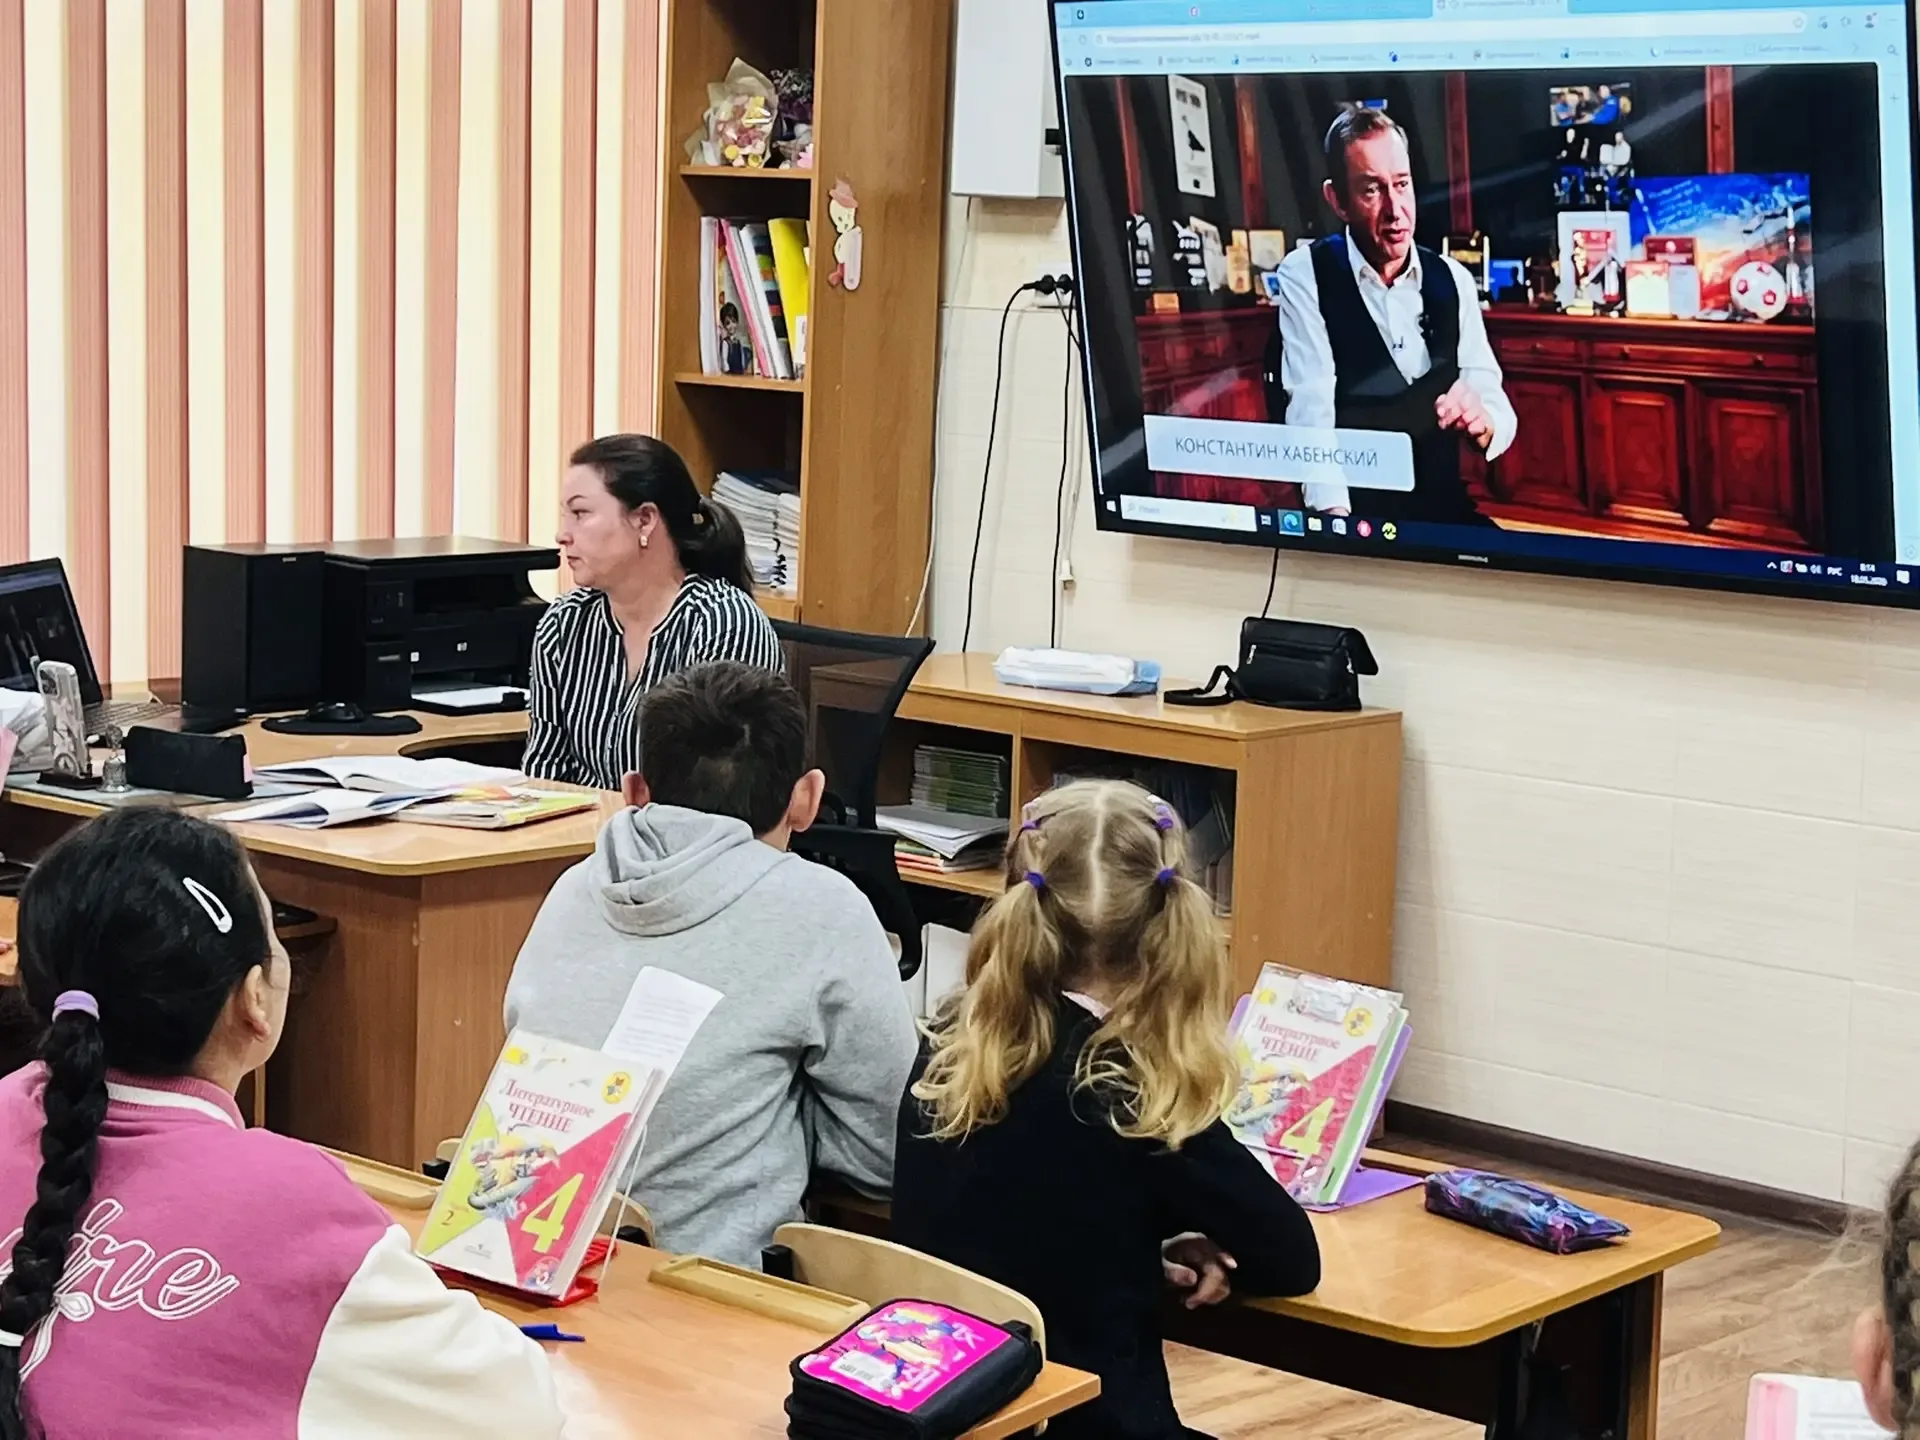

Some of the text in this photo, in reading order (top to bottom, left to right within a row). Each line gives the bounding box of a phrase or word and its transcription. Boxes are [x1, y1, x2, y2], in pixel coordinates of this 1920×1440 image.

[1175, 437, 1378, 467] КОНСТАНТИН ХАБЕНСКИЙ
[1257, 1015, 1341, 1049] Литературное
[1261, 1036, 1318, 1062] ЧТЕНИЕ
[502, 1078, 595, 1118] Литературное
[508, 1102, 573, 1133] ЧТЕНИЕ
[1279, 1096, 1335, 1164] 4
[440, 1209, 454, 1226] 2
[520, 1173, 585, 1254] 4
